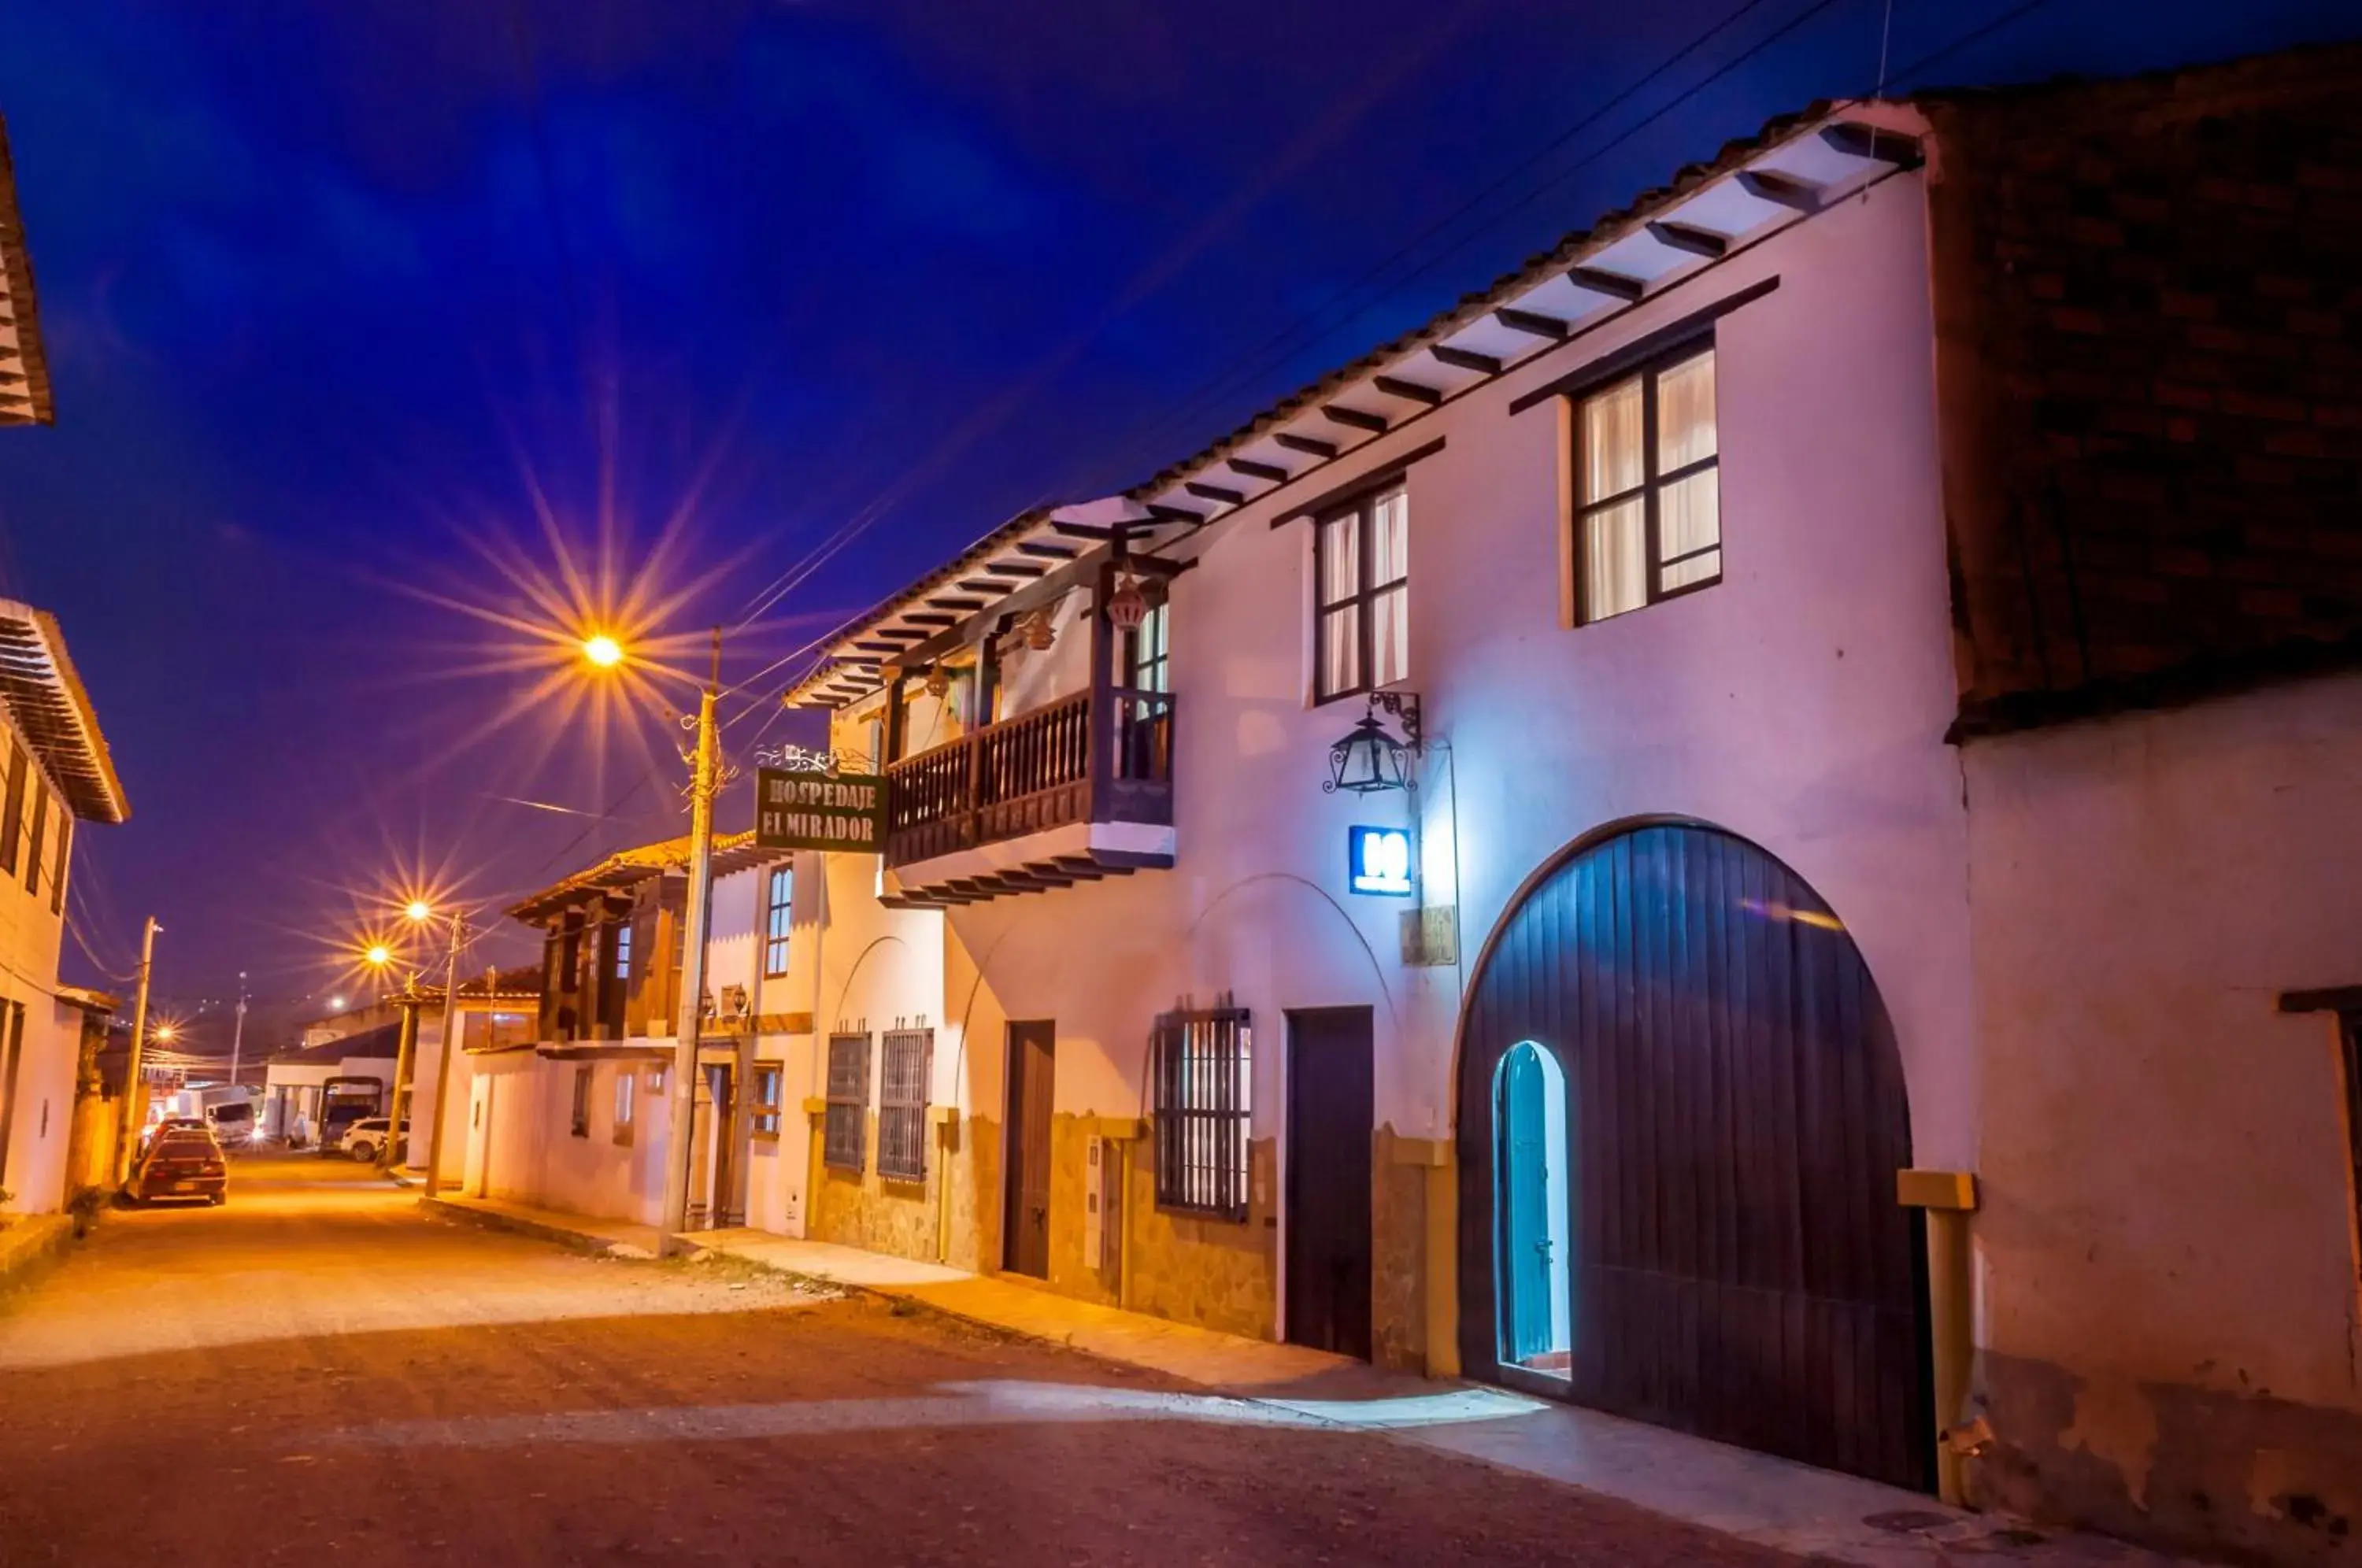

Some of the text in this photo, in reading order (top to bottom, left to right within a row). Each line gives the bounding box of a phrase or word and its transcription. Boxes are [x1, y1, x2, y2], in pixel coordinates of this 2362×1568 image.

[769, 779, 876, 811] HOSPEDAJE
[762, 811, 874, 841] EL MIRADOR
